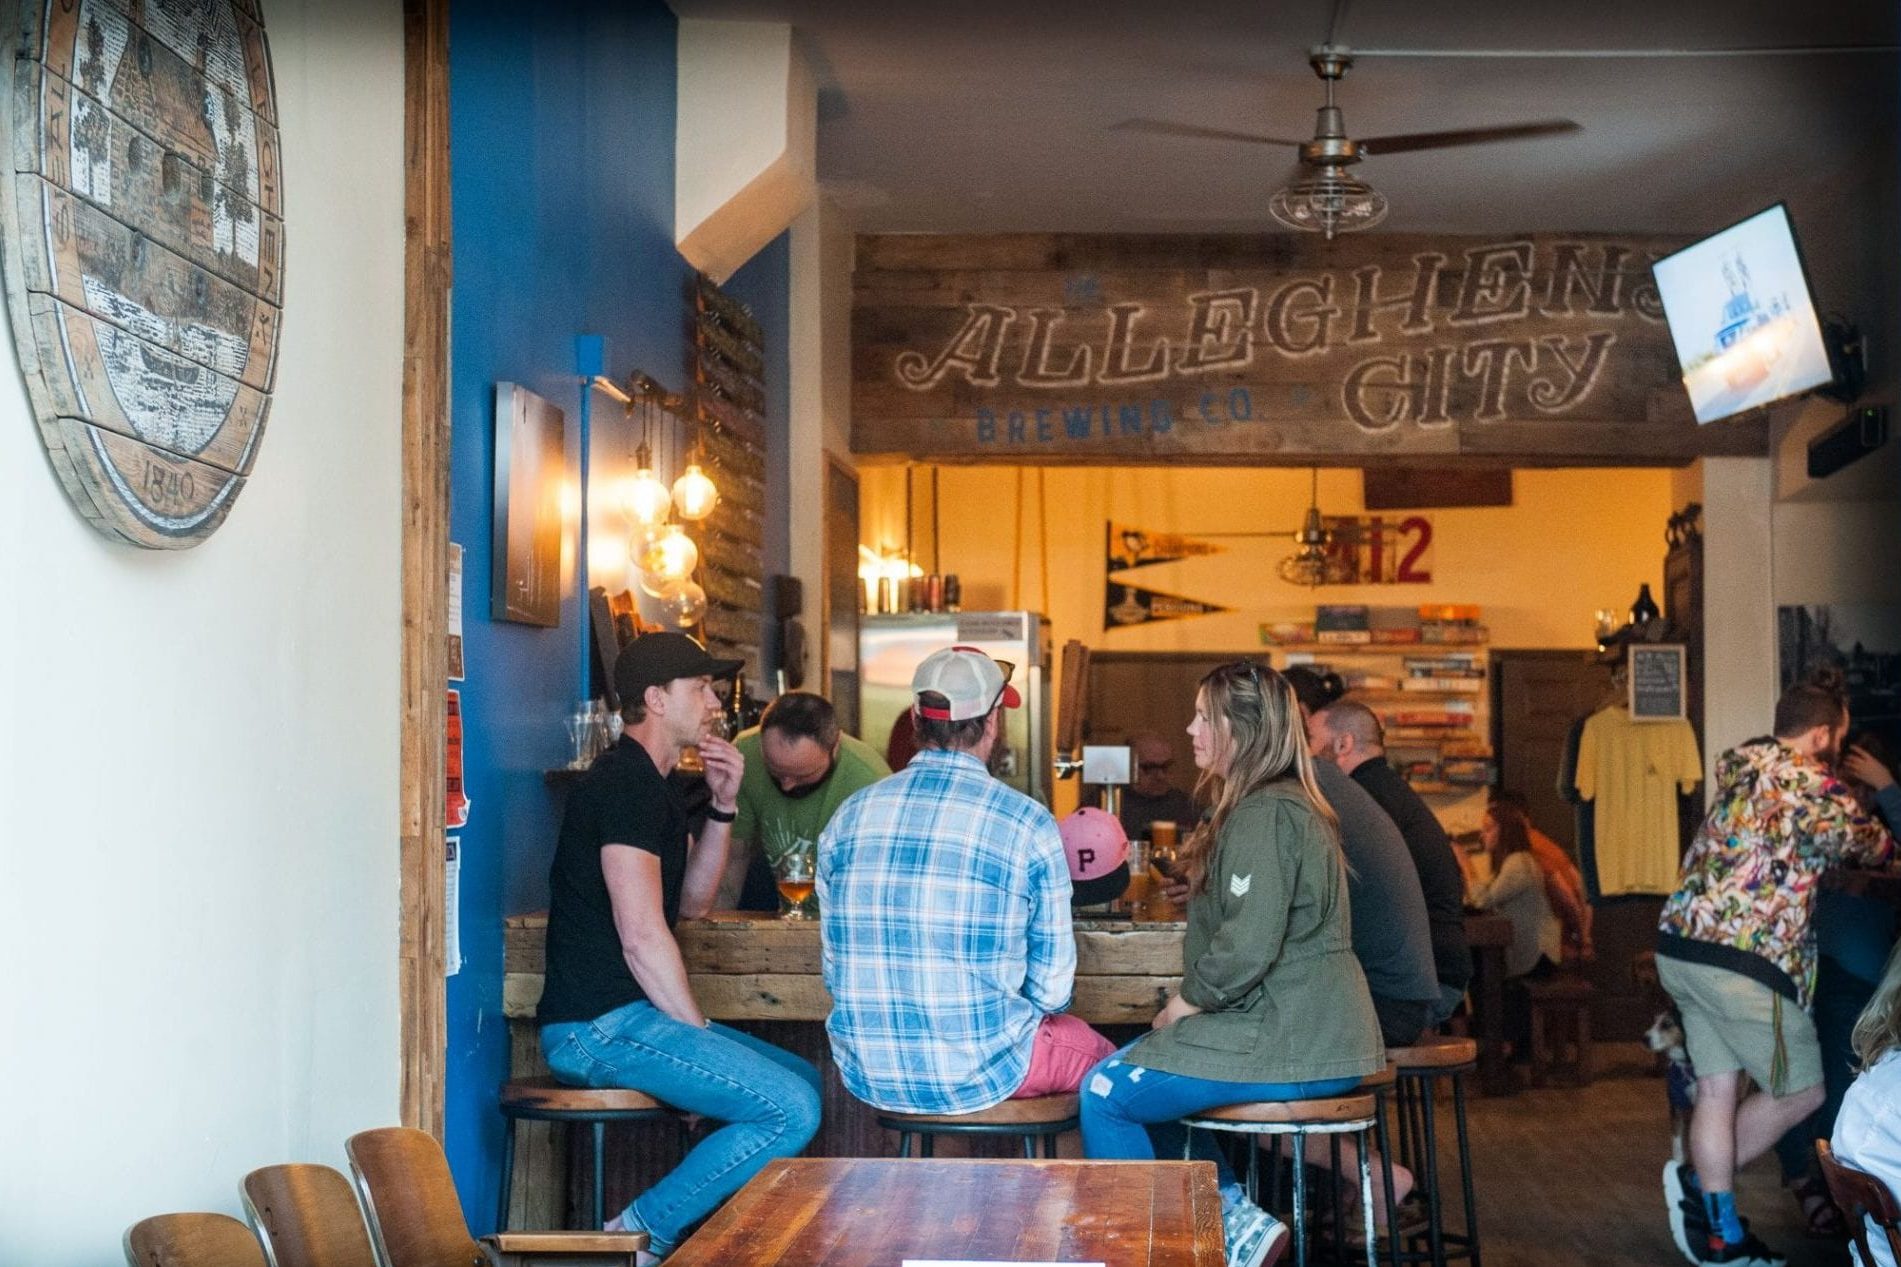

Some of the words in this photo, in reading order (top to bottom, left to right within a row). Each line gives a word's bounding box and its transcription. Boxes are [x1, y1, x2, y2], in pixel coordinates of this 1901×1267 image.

[51, 63, 70, 244] SEAL
[1341, 330, 1617, 434] CITY
[976, 399, 1174, 444] BREWING
[143, 460, 194, 505] 1840
[1077, 848, 1095, 872] P
